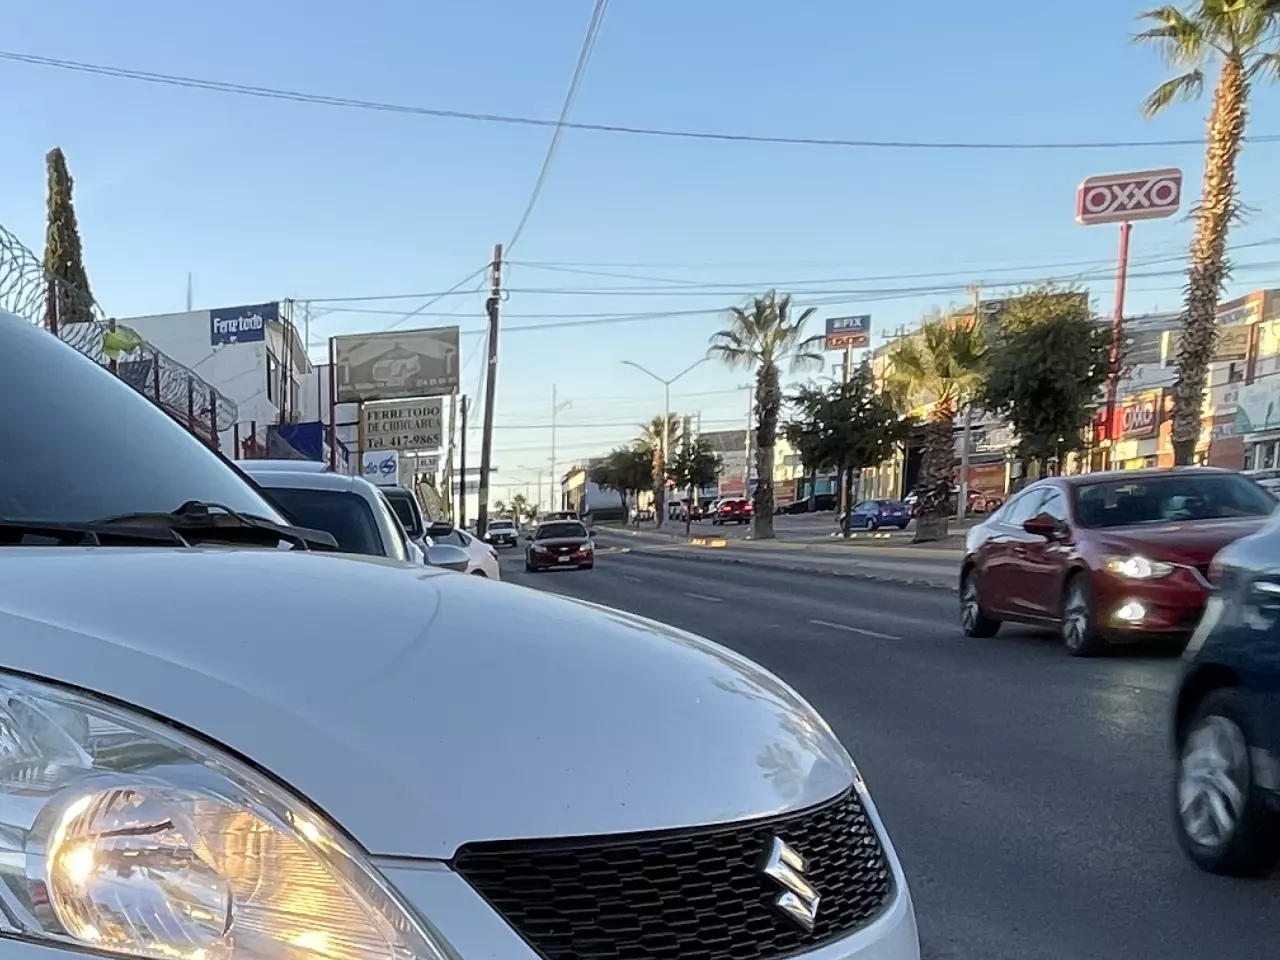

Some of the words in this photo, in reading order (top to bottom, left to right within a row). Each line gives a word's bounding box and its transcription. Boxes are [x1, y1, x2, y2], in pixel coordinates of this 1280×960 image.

[1084, 179, 1177, 214] OXXO
[367, 406, 440, 421] FERRETODO
[368, 421, 379, 433] DE
